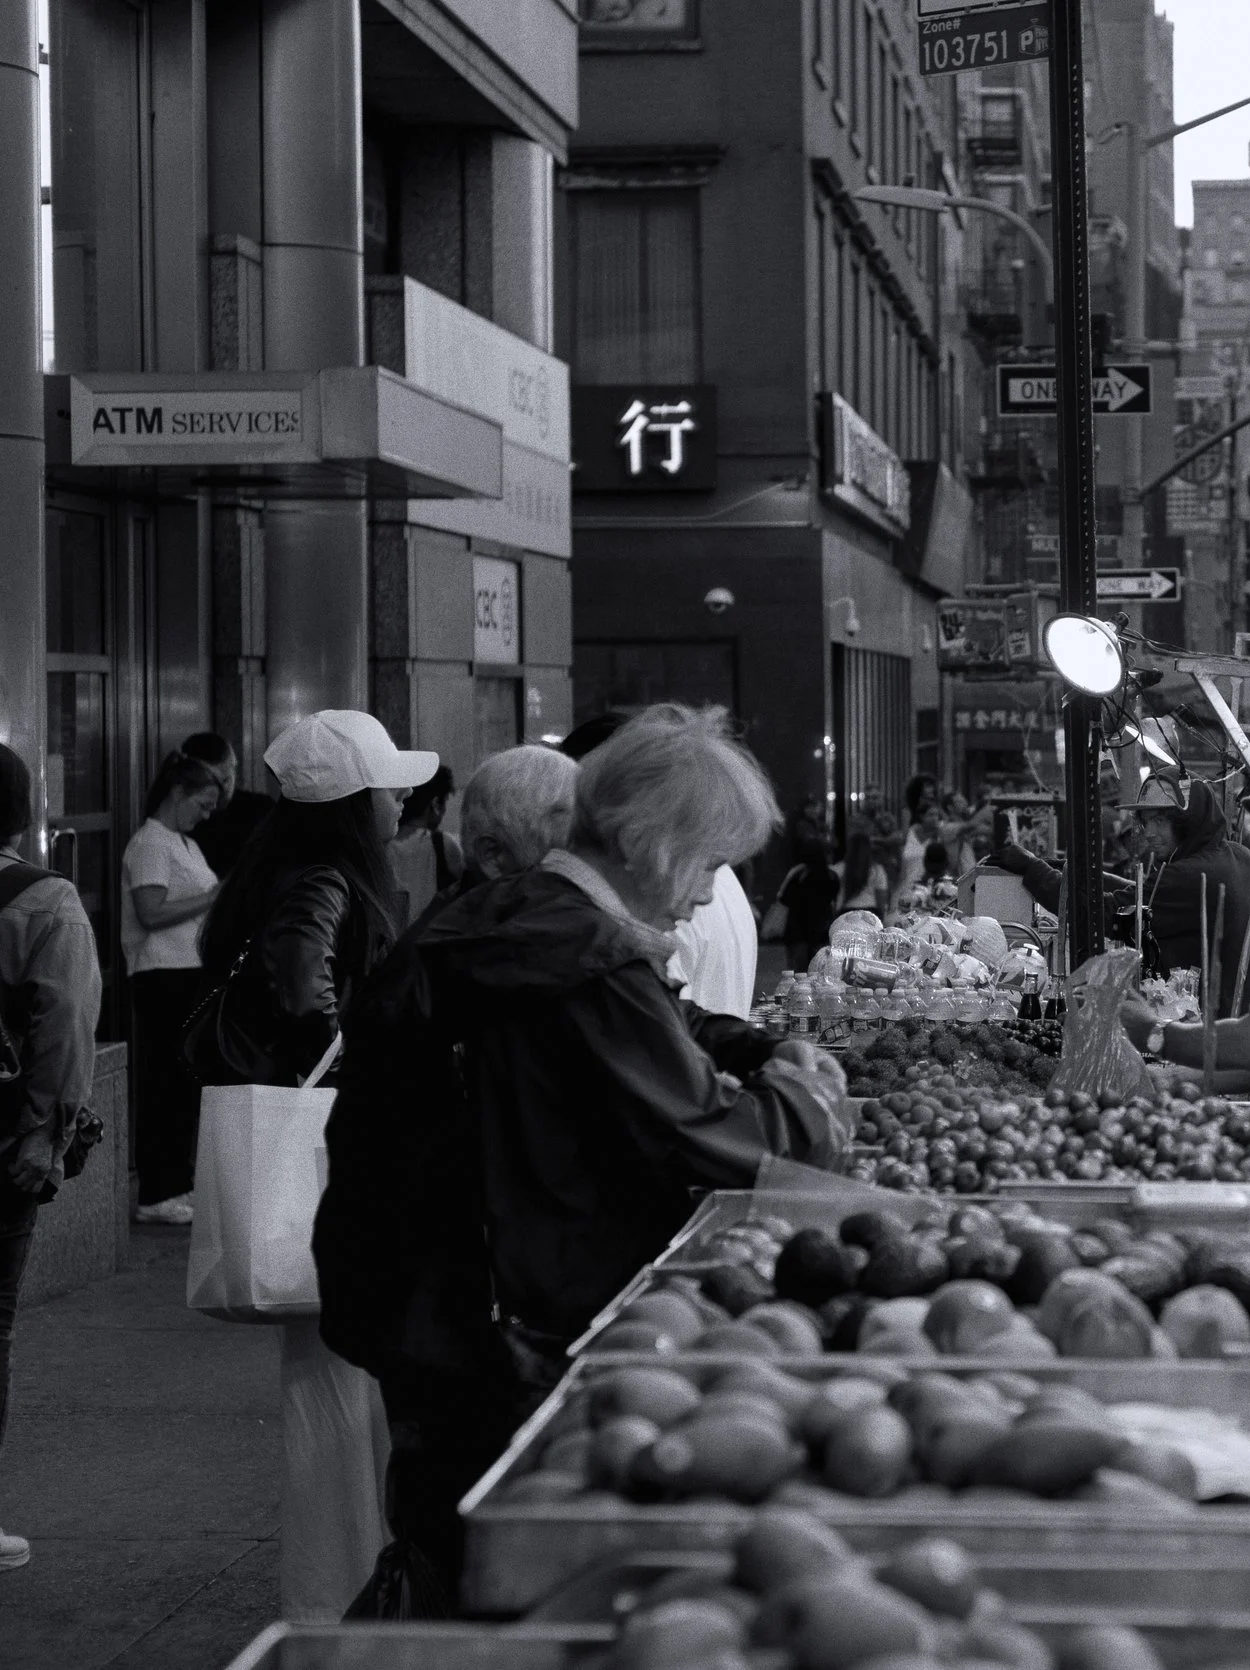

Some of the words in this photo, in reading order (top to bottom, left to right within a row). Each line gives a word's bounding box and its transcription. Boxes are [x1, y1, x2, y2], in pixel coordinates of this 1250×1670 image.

[922, 19, 961, 34] Zone#
[923, 29, 1008, 71] 103751
[92, 406, 163, 435] ATM
